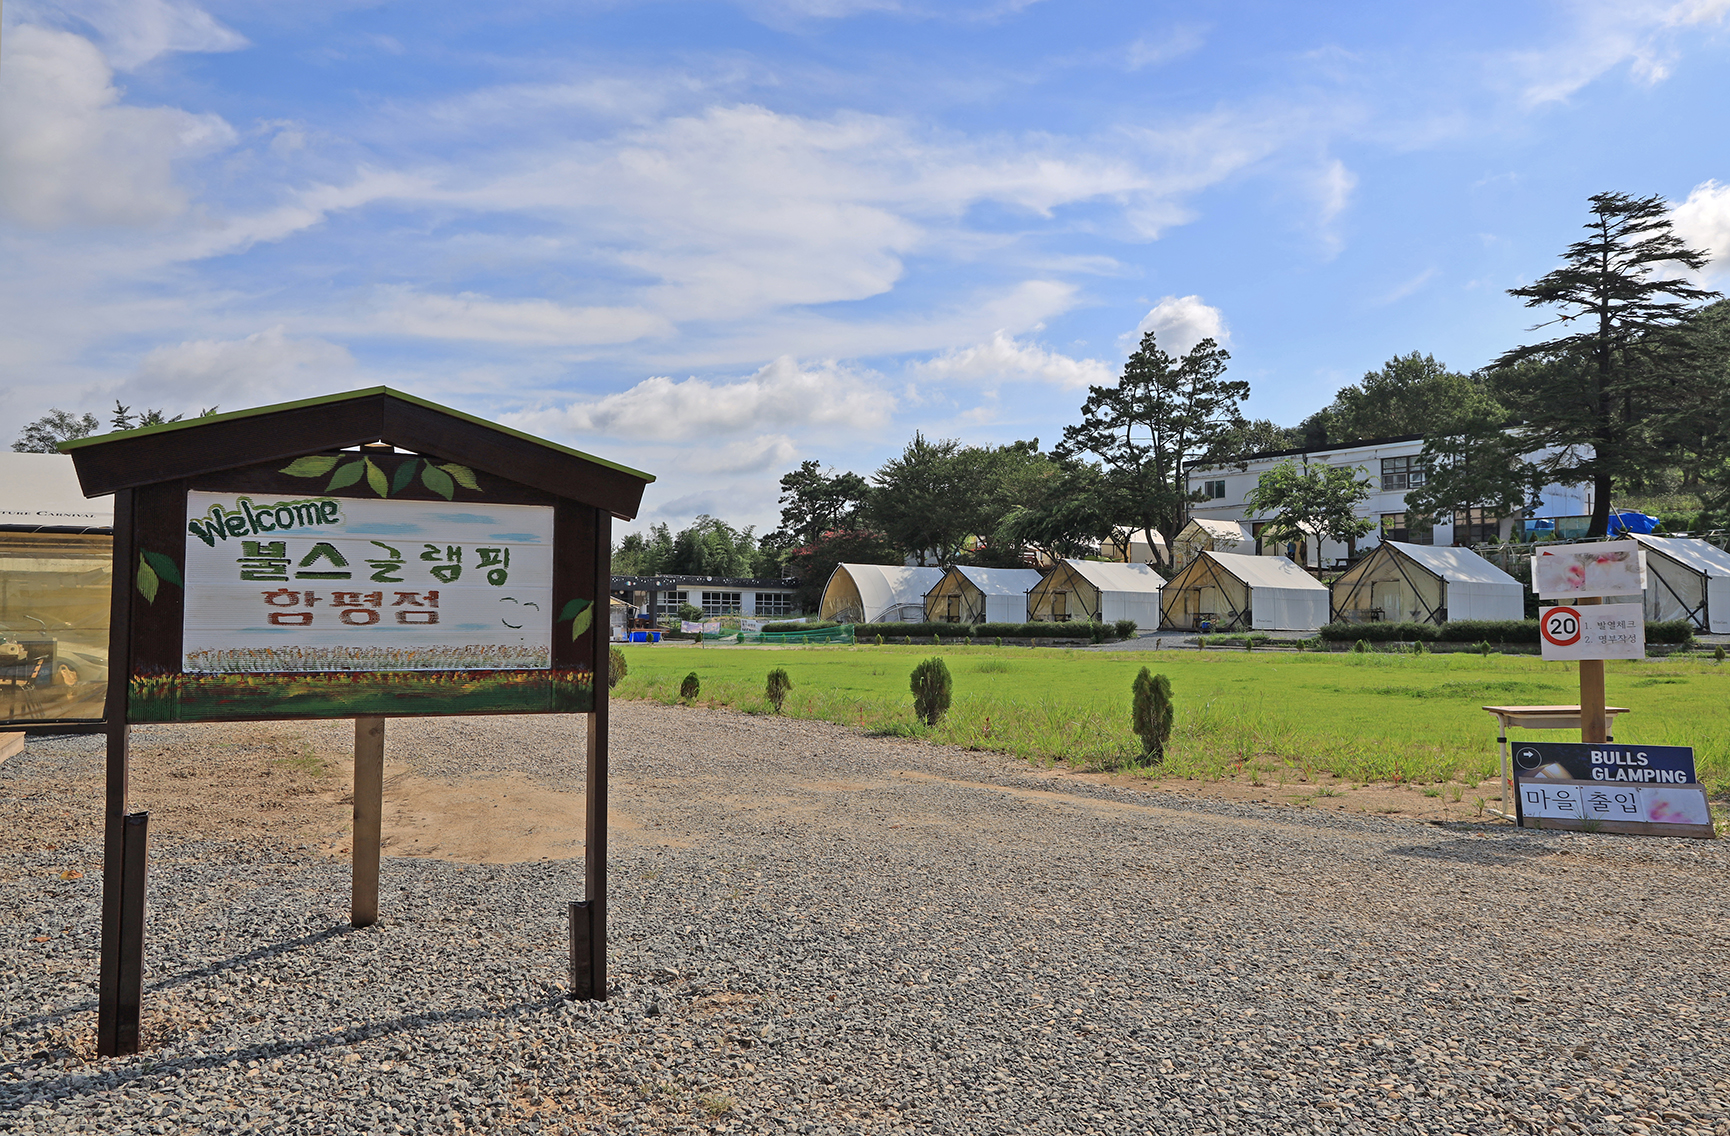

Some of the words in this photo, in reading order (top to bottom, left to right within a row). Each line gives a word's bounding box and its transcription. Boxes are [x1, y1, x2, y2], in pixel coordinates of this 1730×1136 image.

[189, 500, 340, 547] Welcome
[260, 588, 440, 626] 함평점
[1550, 618, 1576, 635] 20
[1597, 620, 1636, 630] 발열체크
[1598, 634, 1636, 644] 명부작성
[1590, 750, 1649, 766] BULLS
[1591, 767, 1687, 784] GLAMPING
[1526, 789, 1577, 812] 마을
[1588, 791, 1638, 814] 출입
